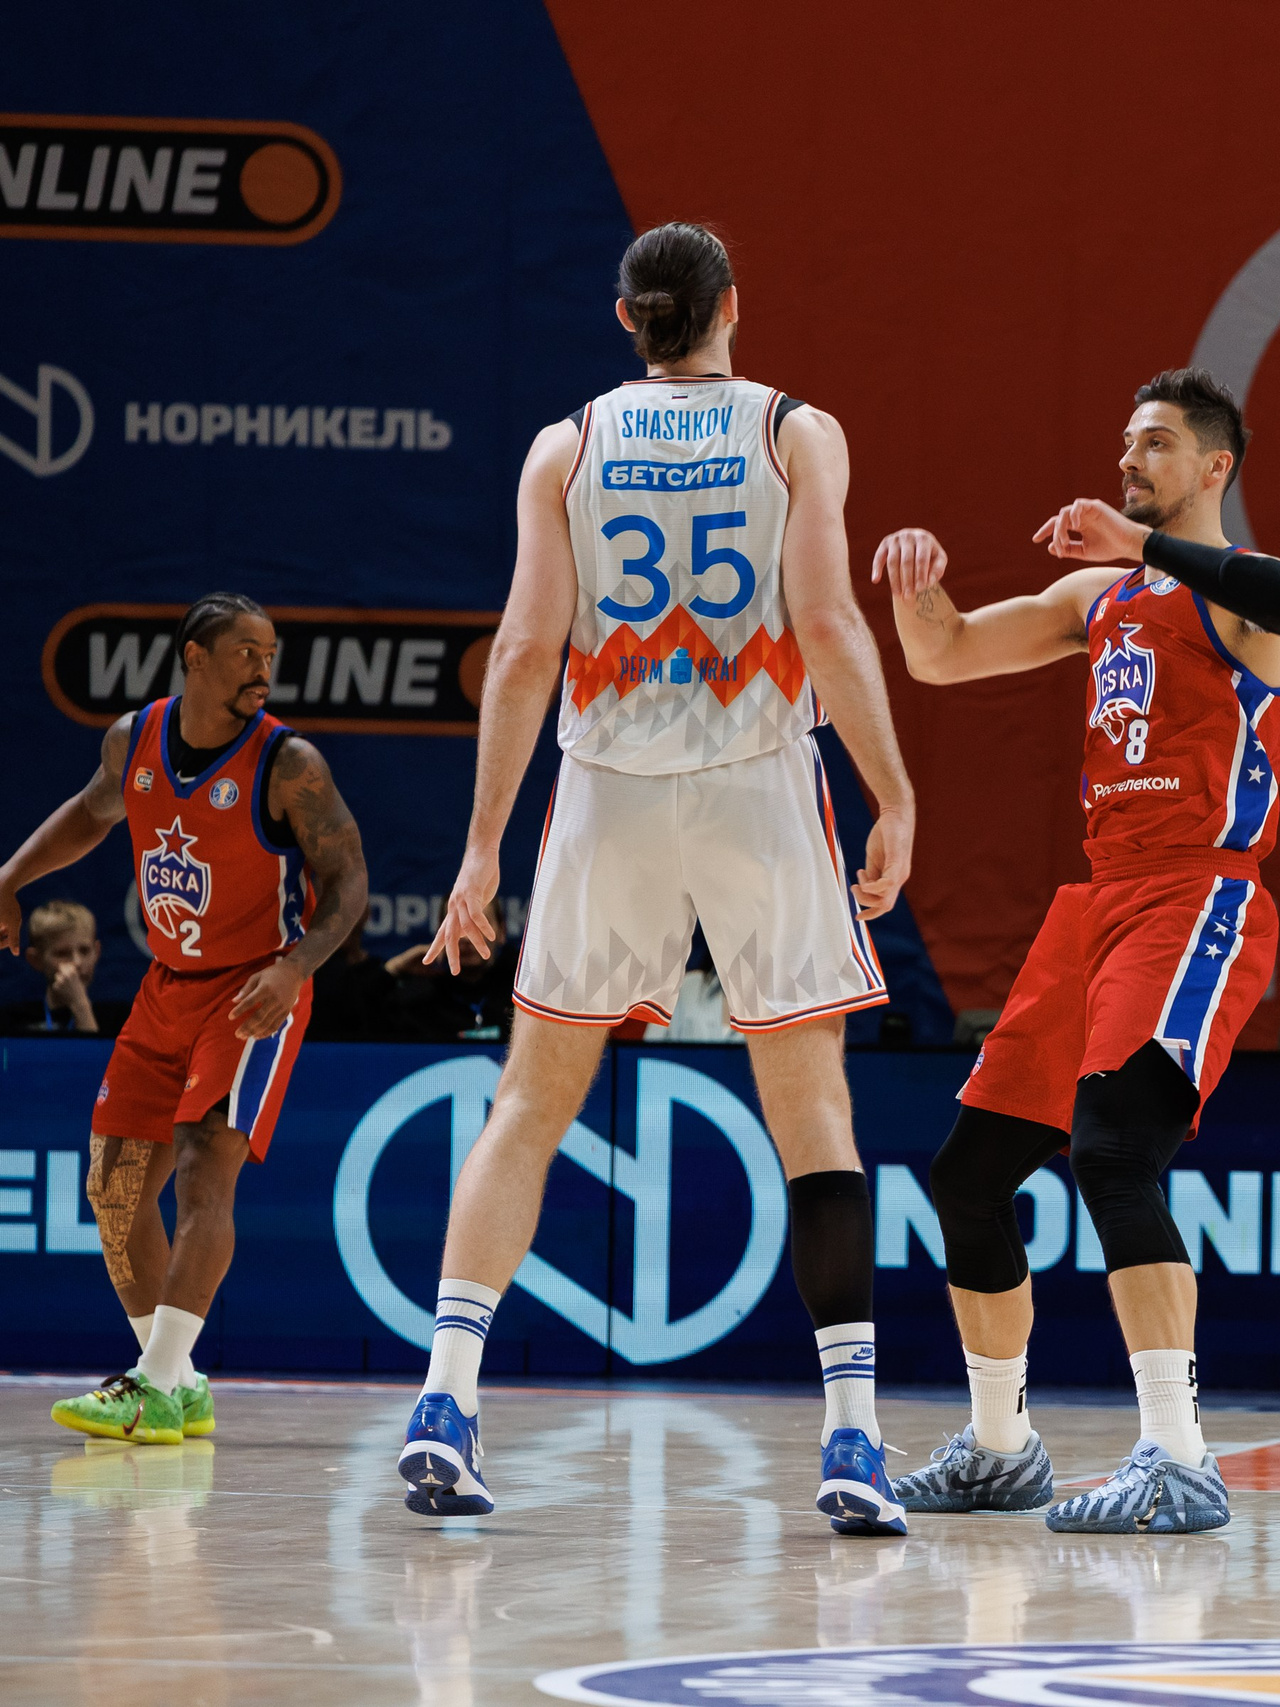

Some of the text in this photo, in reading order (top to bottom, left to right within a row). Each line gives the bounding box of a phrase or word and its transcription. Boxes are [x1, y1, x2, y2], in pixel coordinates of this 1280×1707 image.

[125, 402, 453, 452] НОРНИКЕЛЬ
[621, 405, 734, 441] SHASHKOV
[607, 461, 742, 487] БЕТСИТИ
[596, 510, 756, 622] 35
[89, 632, 446, 706] WLINE
[620, 656, 663, 684] PERM
[1101, 664, 1143, 697] CSKA
[1125, 719, 1149, 765] 8
[1092, 777, 1180, 801] Ростелеком
[148, 864, 200, 893] CSKA
[179, 920, 202, 957] 2
